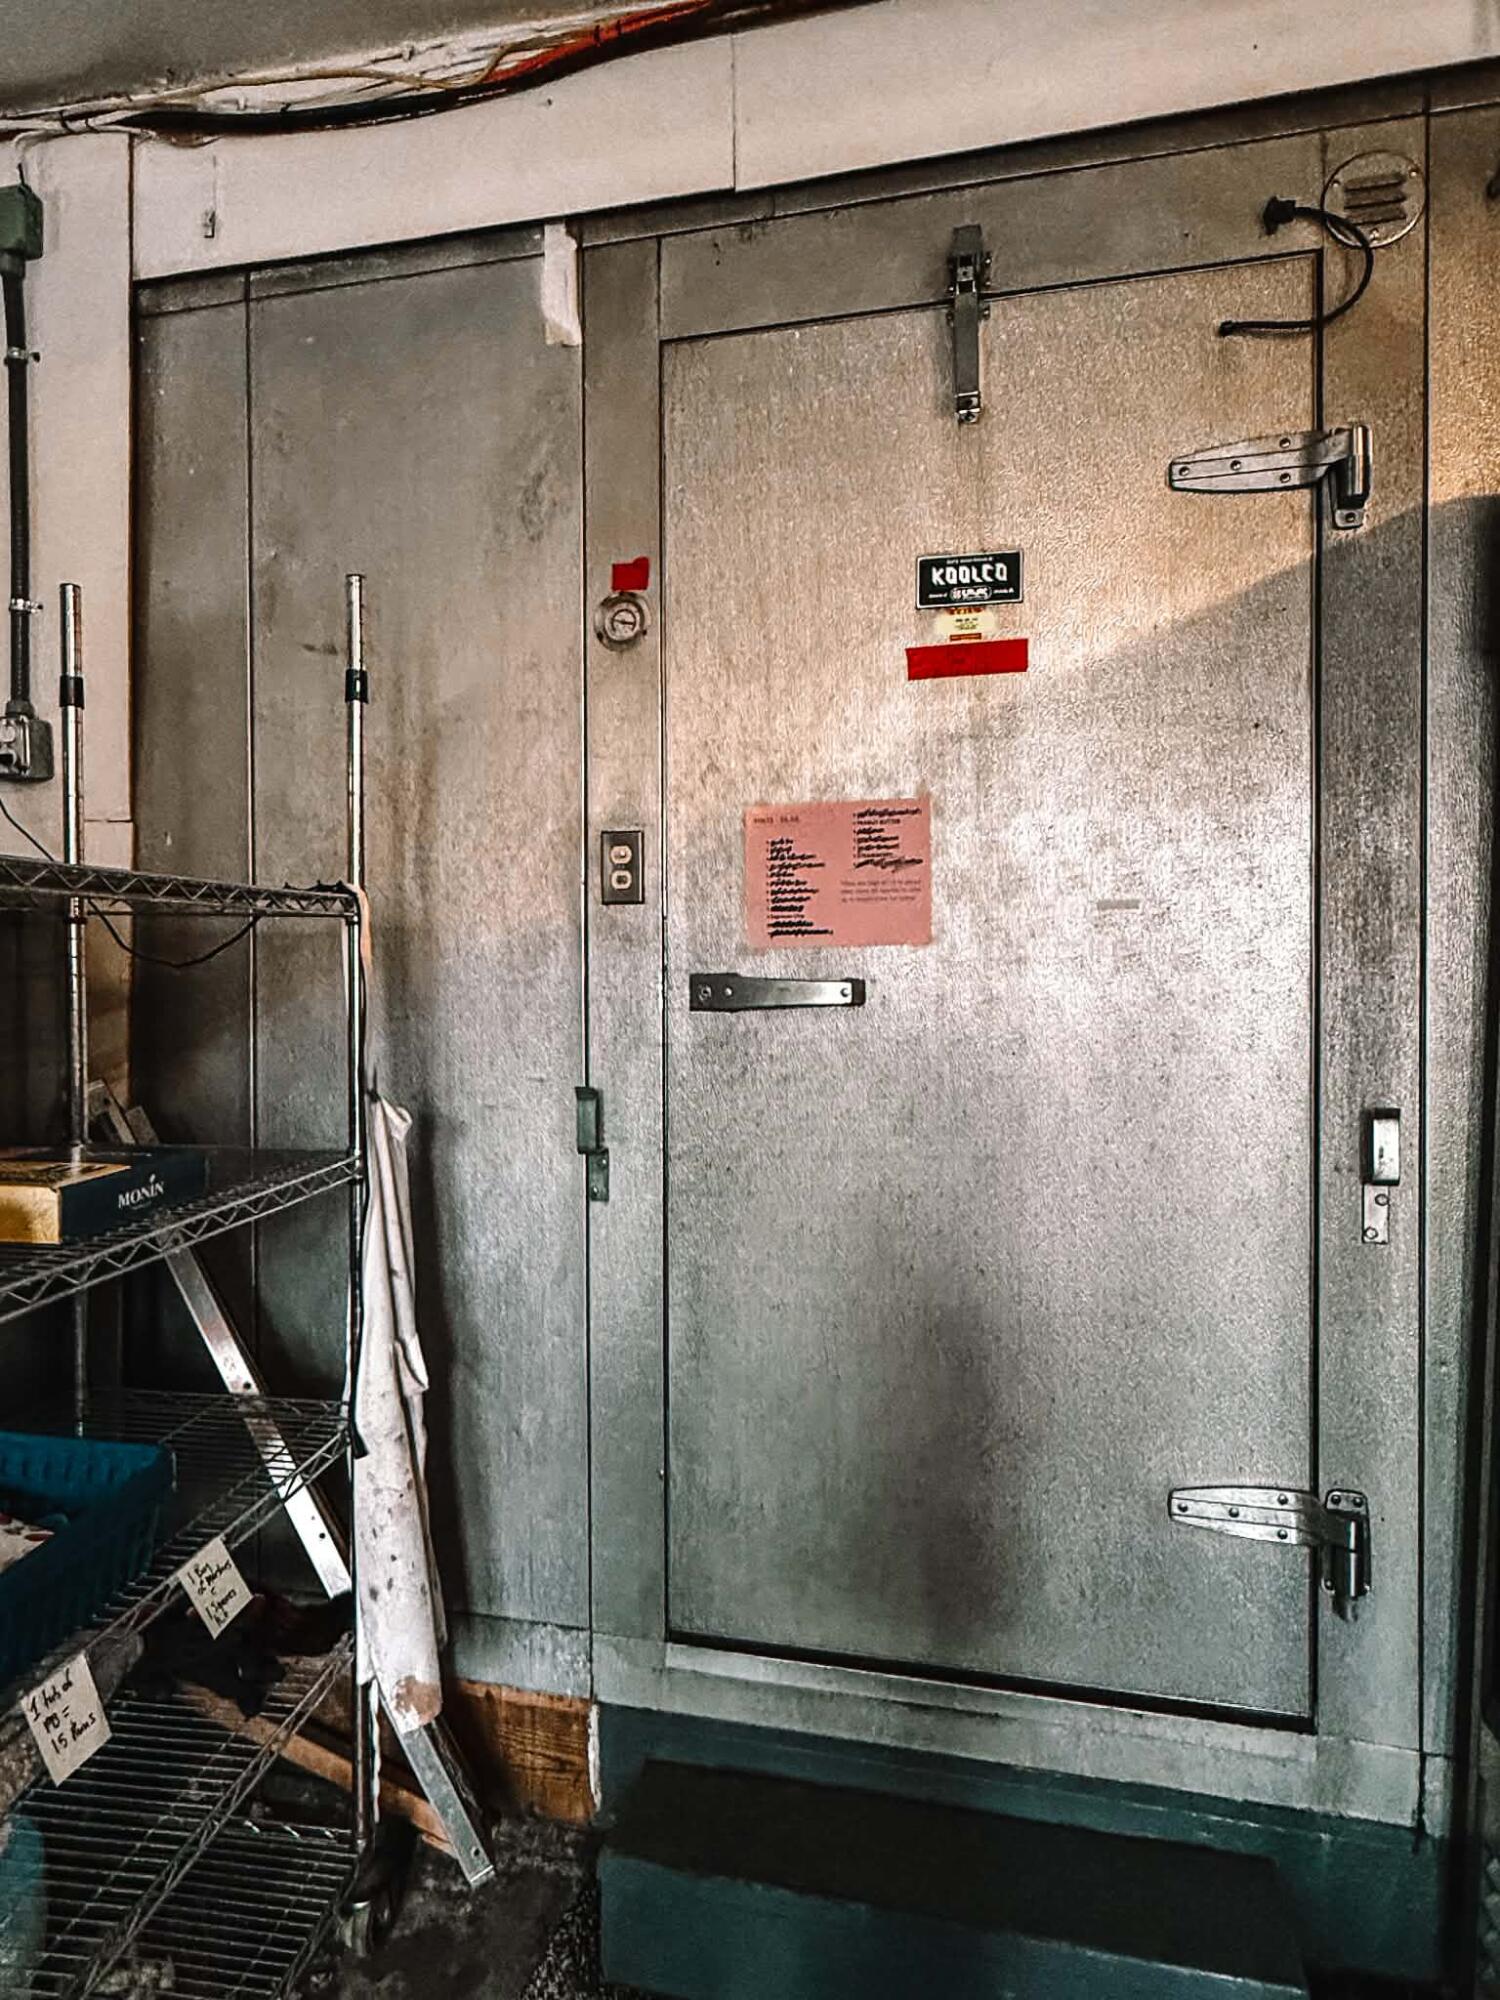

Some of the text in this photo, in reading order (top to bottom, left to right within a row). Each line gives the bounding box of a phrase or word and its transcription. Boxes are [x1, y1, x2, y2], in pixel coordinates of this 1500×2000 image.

[930, 563, 1008, 587] KOOLCO
[117, 1173, 165, 1209] MONIN
[51, 1733, 68, 1755] 15
